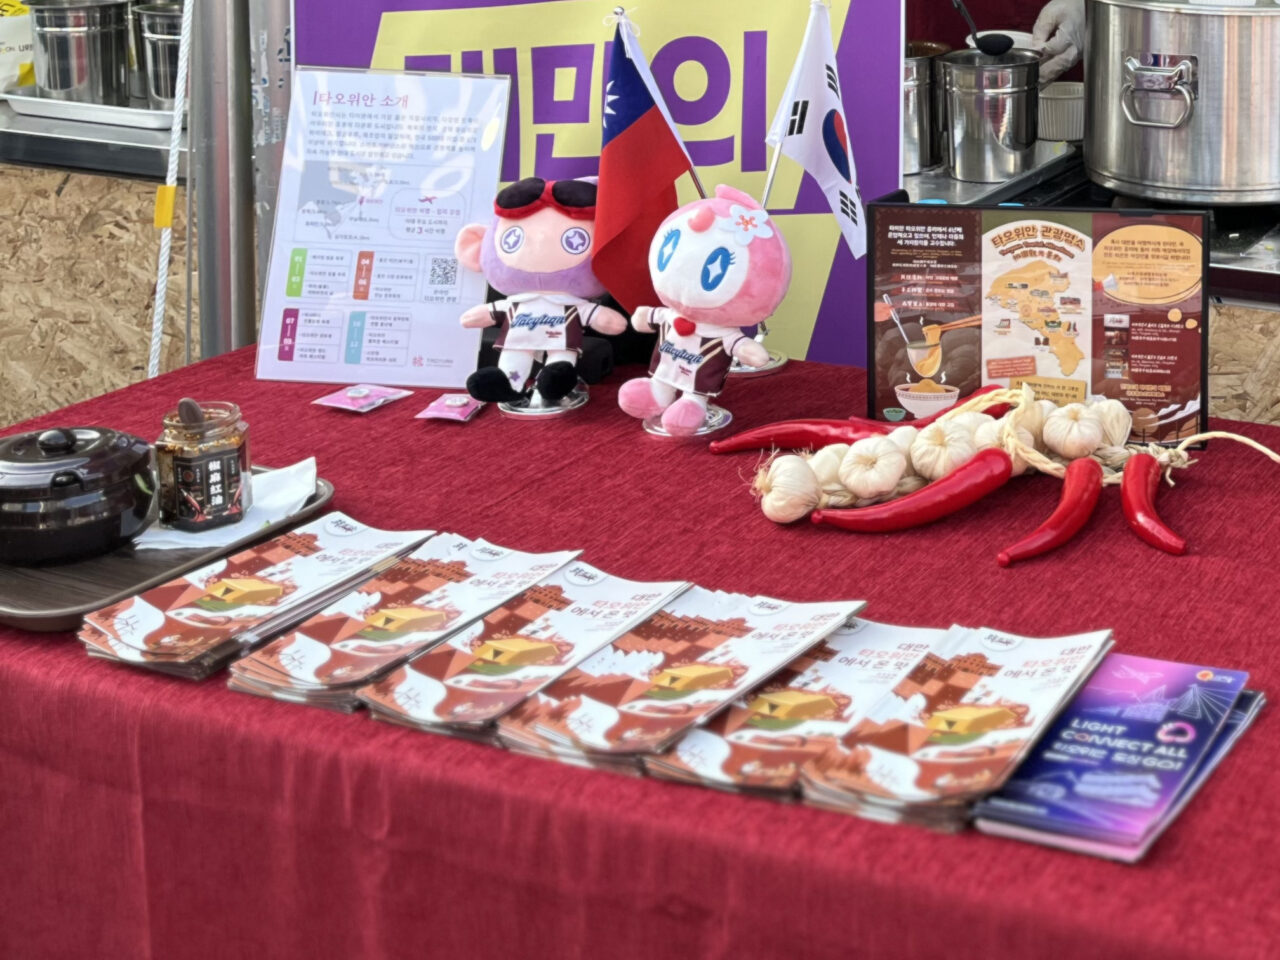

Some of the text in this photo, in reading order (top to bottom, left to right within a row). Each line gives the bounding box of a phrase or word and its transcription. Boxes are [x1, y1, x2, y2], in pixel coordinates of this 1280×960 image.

[318, 91, 409, 109] 타오위안 소개
[991, 224, 1037, 249] 타오위안
[1071, 718, 1128, 736] LIGHT
[1060, 729, 1155, 753] CONNECT
[1153, 744, 1189, 759] ALL
